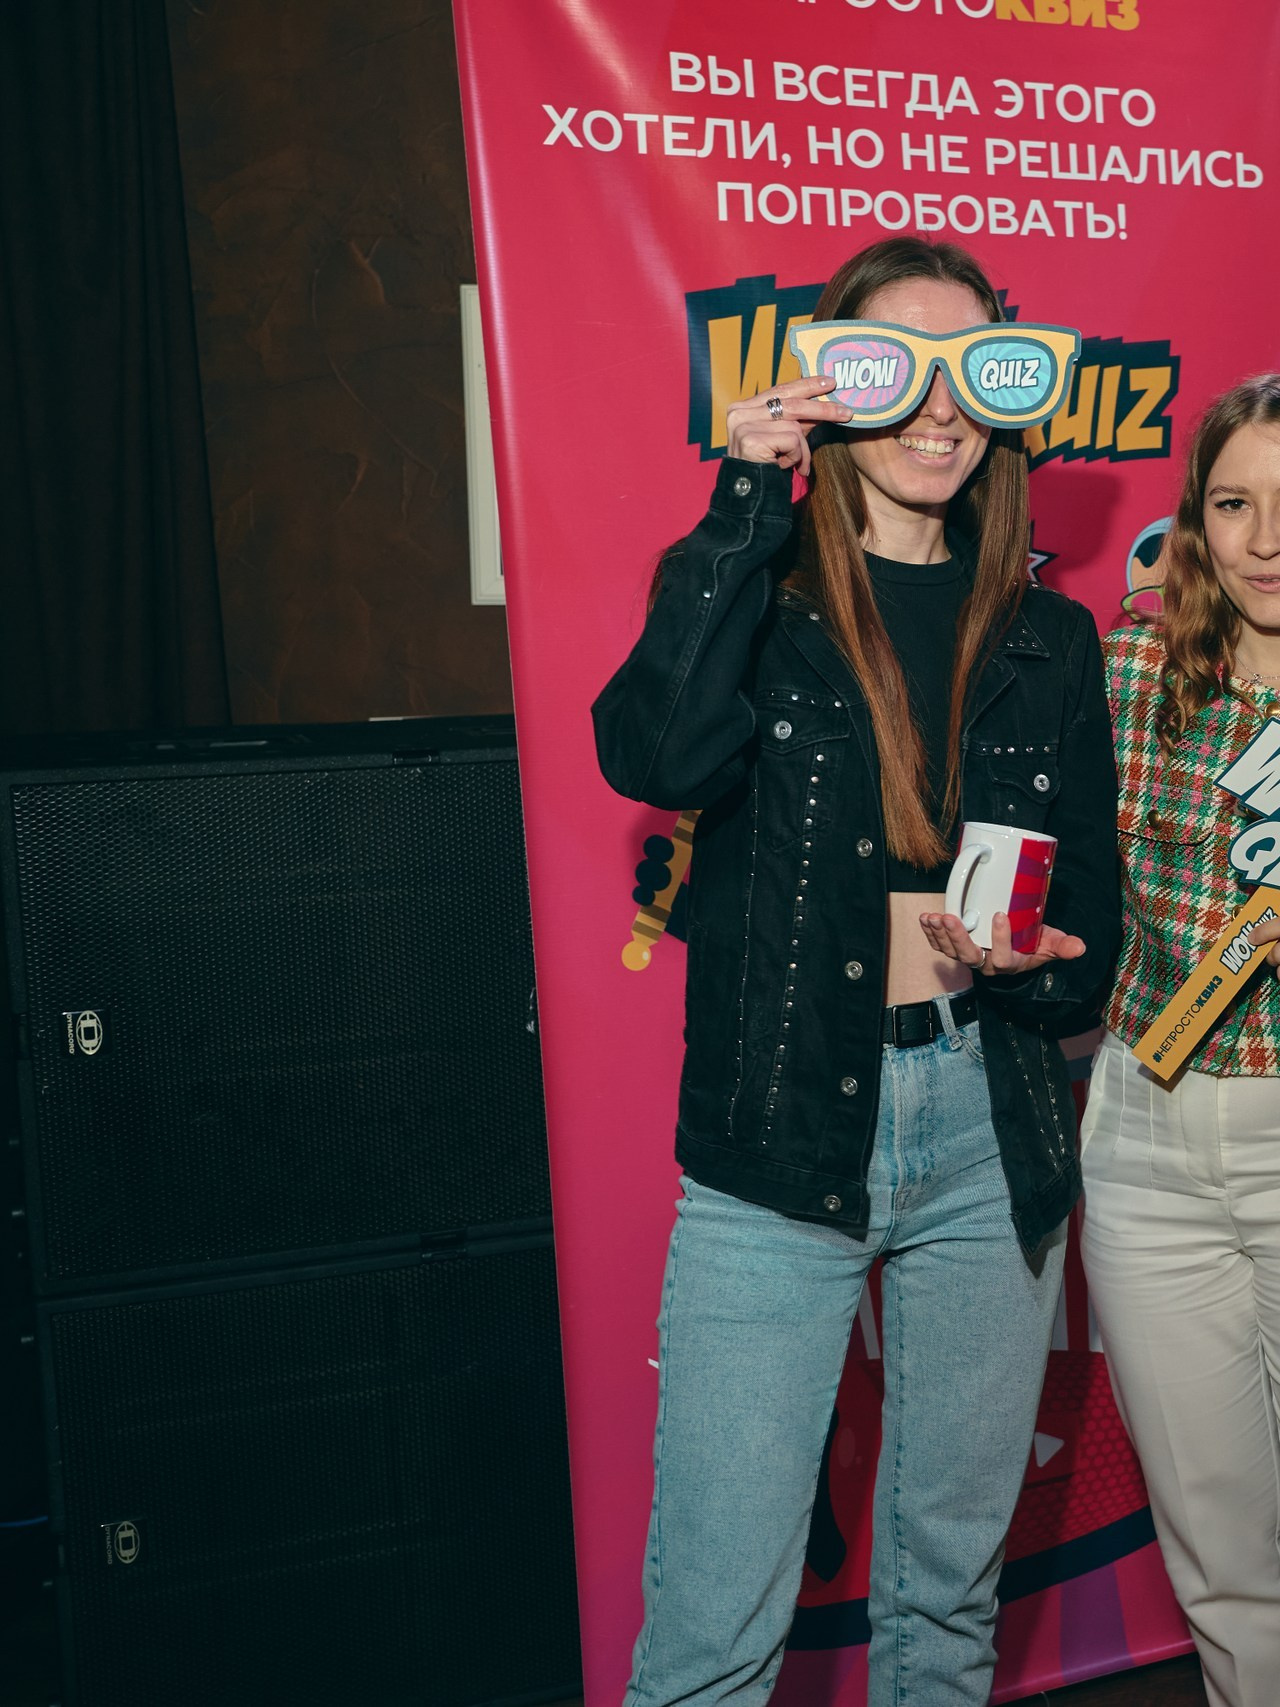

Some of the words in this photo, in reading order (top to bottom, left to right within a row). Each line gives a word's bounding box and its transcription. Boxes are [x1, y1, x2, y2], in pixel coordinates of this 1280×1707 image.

[669, 51, 755, 98] ВЫ
[773, 61, 980, 121] ВСЕГДА
[993, 78, 1156, 127] ЭТОГО
[542, 104, 792, 169] ХОТЕЛИ,
[807, 125, 884, 169] НО
[901, 132, 970, 174] НЕ
[985, 137, 1264, 189] РЕШАЛИСЬ
[717, 181, 1128, 240] ПОПРОБОВАТЬ!
[833, 356, 898, 390] WOW
[979, 356, 1041, 391] QUIZ
[1022, 364, 1172, 458] UIZ
[66, 1013, 75, 1054] DYNACORD
[1152, 974, 1224, 1064] #НЕПРОСТОКВИЗ
